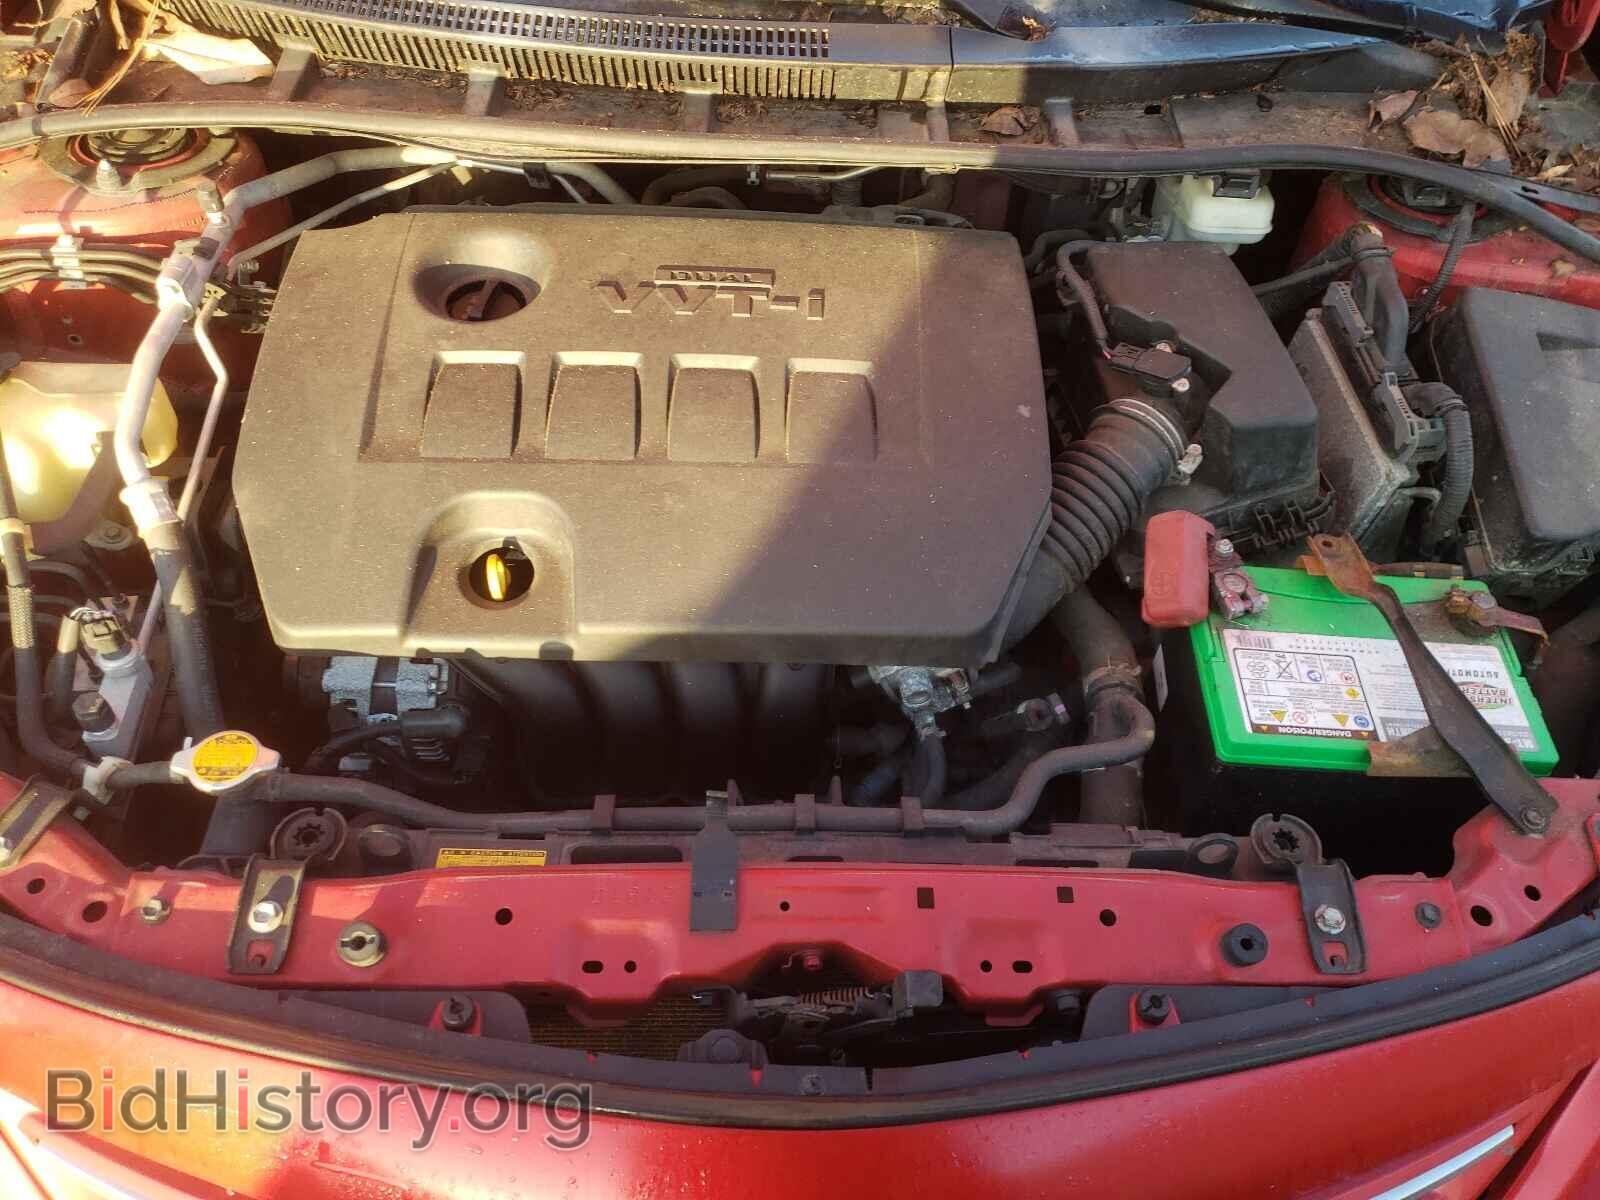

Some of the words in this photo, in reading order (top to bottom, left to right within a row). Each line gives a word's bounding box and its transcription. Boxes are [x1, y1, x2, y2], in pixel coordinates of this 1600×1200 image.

[670, 271, 762, 283] DUAL
[1460, 687, 1506, 697] BATTER
[1467, 696, 1512, 706] INTERS
